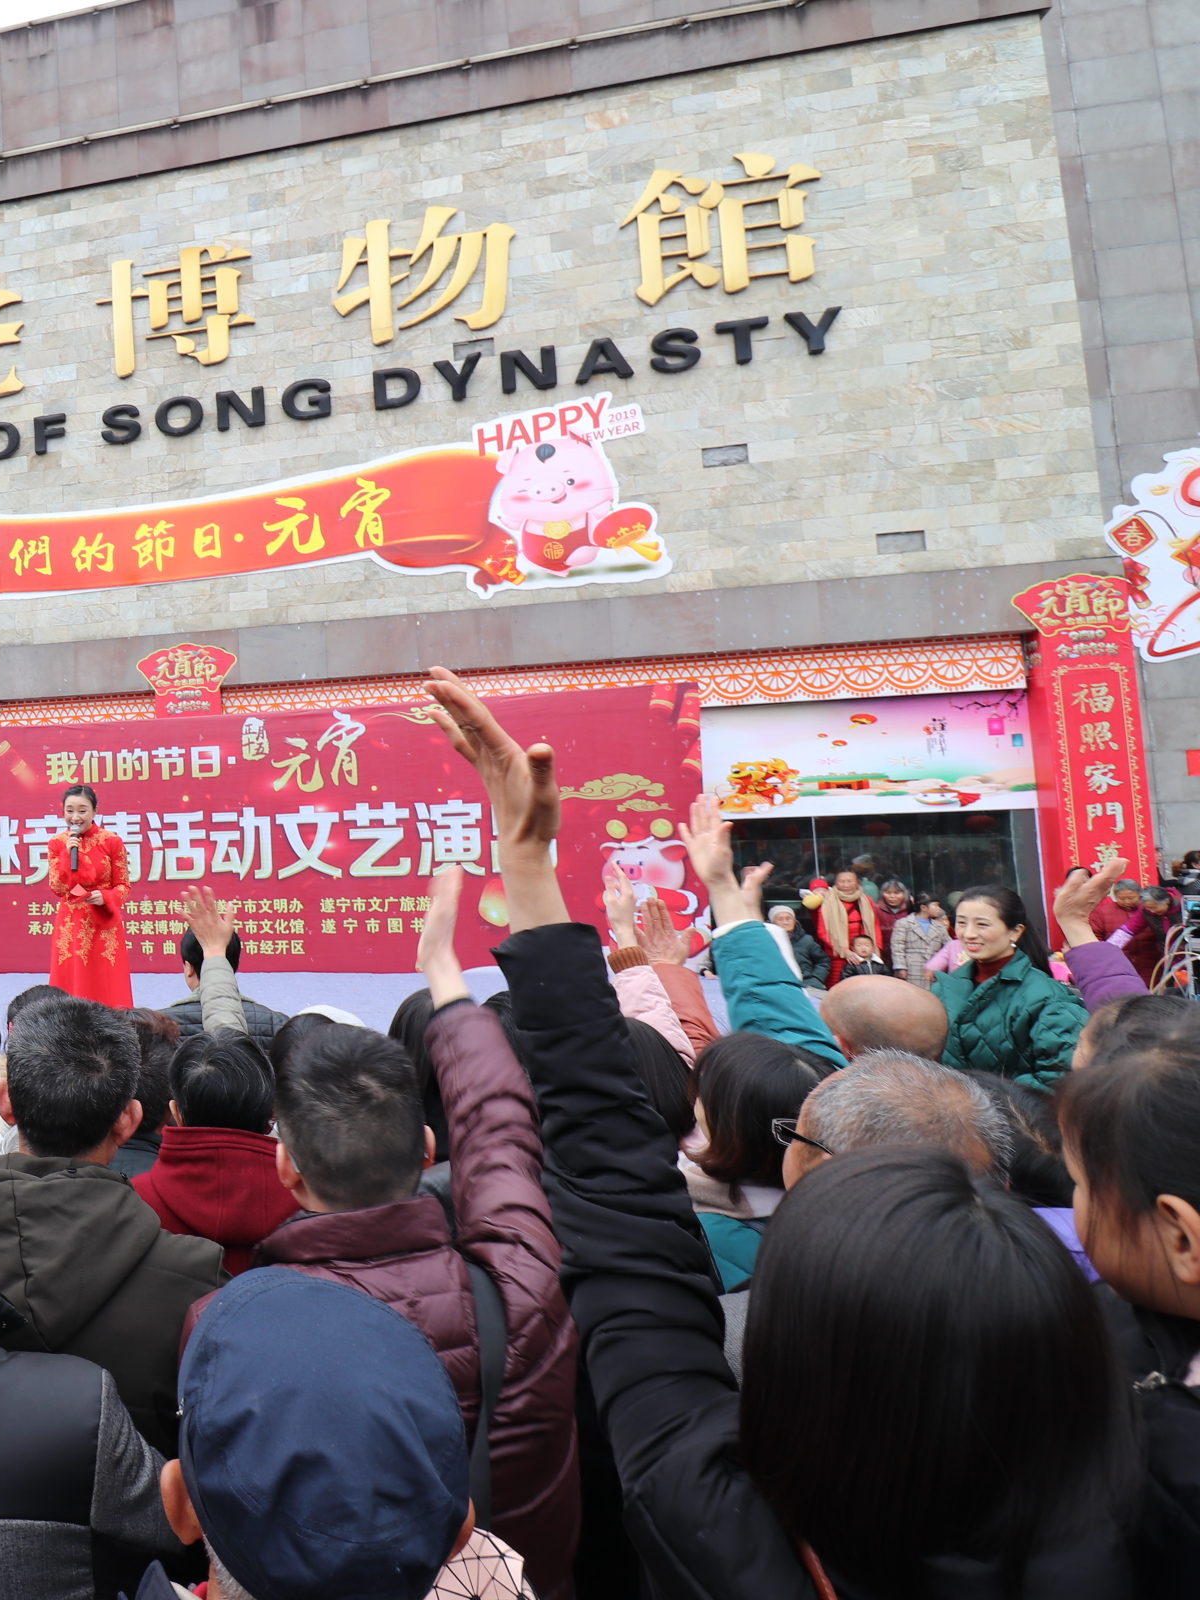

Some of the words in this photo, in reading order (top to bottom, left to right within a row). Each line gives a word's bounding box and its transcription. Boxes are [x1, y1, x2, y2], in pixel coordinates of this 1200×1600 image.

[101, 378, 332, 445] SONG
[373, 306, 842, 411] DYNASTY
[477, 397, 607, 457] HAPPY
[608, 408, 637, 424] 2019
[576, 429, 604, 445] NEW
[606, 421, 641, 438] YEAR
[1118, 521, 1147, 547] 春
[271, 710, 367, 793] 元宵
